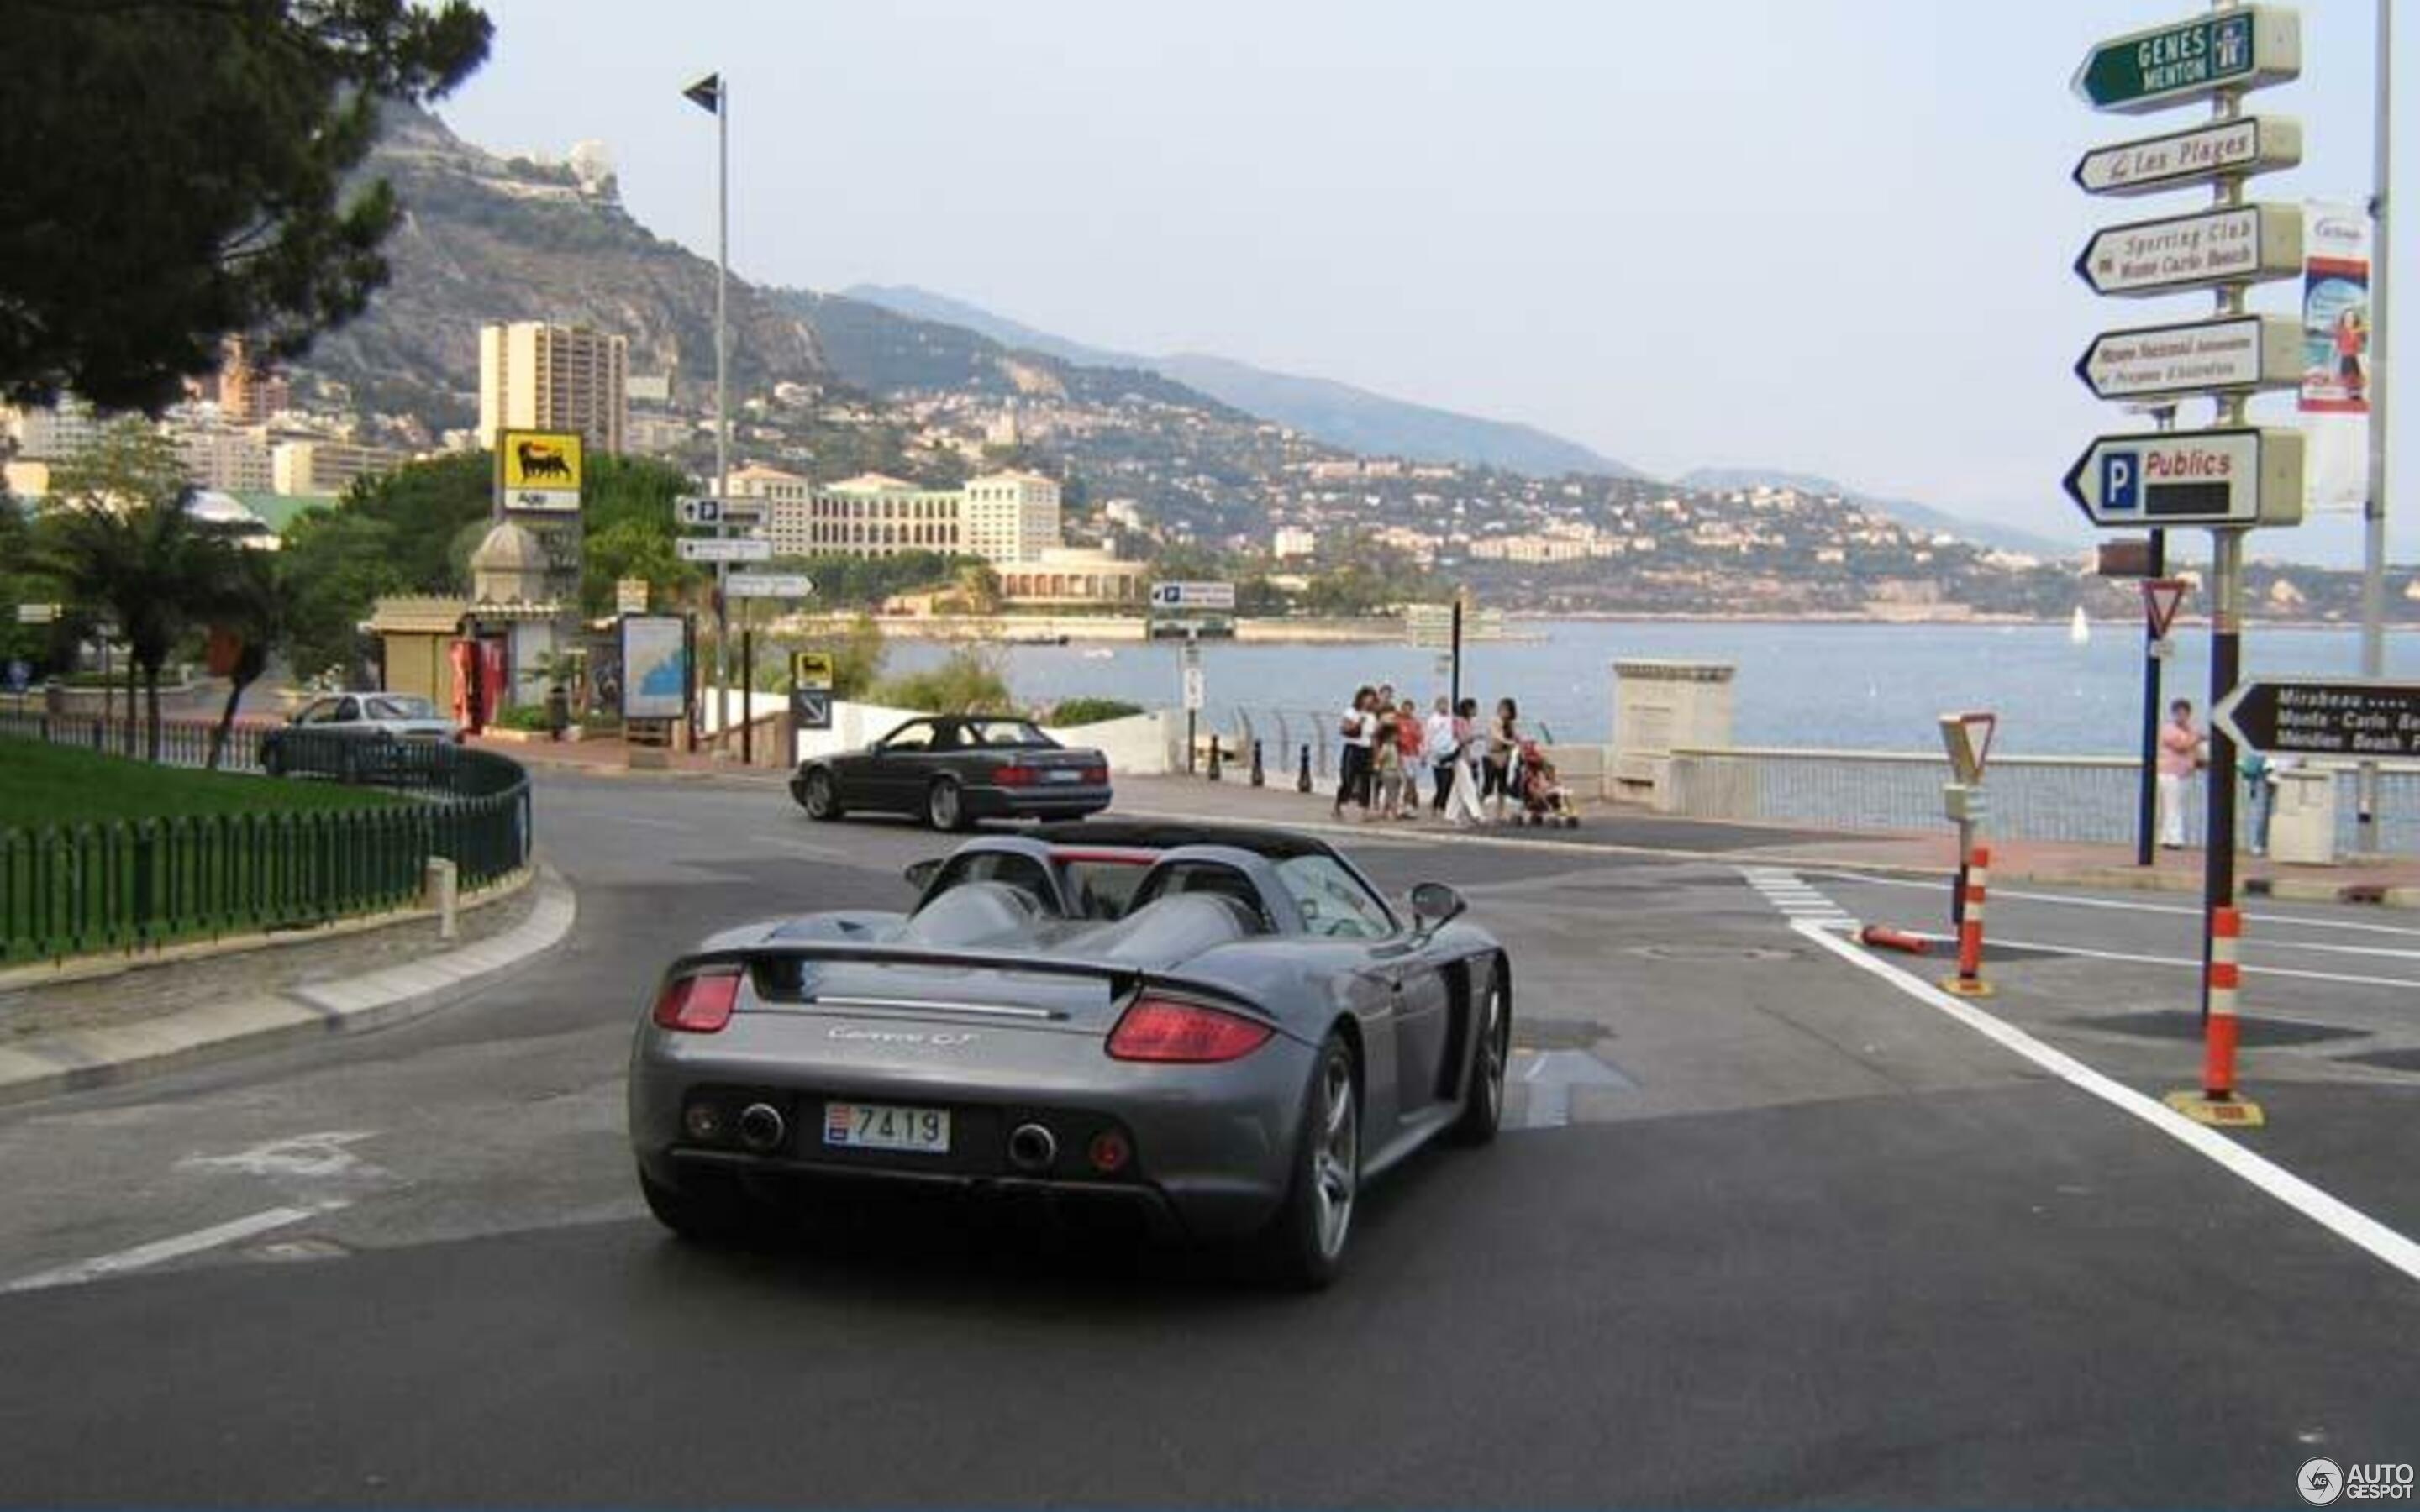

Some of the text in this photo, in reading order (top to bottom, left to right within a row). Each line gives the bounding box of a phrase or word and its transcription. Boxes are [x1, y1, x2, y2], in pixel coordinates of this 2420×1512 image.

[2138, 26, 2206, 68] GENES
[2143, 55, 2206, 92] MENTON
[2179, 134, 2247, 166] Plages
[2125, 219, 2251, 260] Sporting Club
[2108, 449, 2233, 503] P Publics
[858, 1105, 939, 1142] 7419
